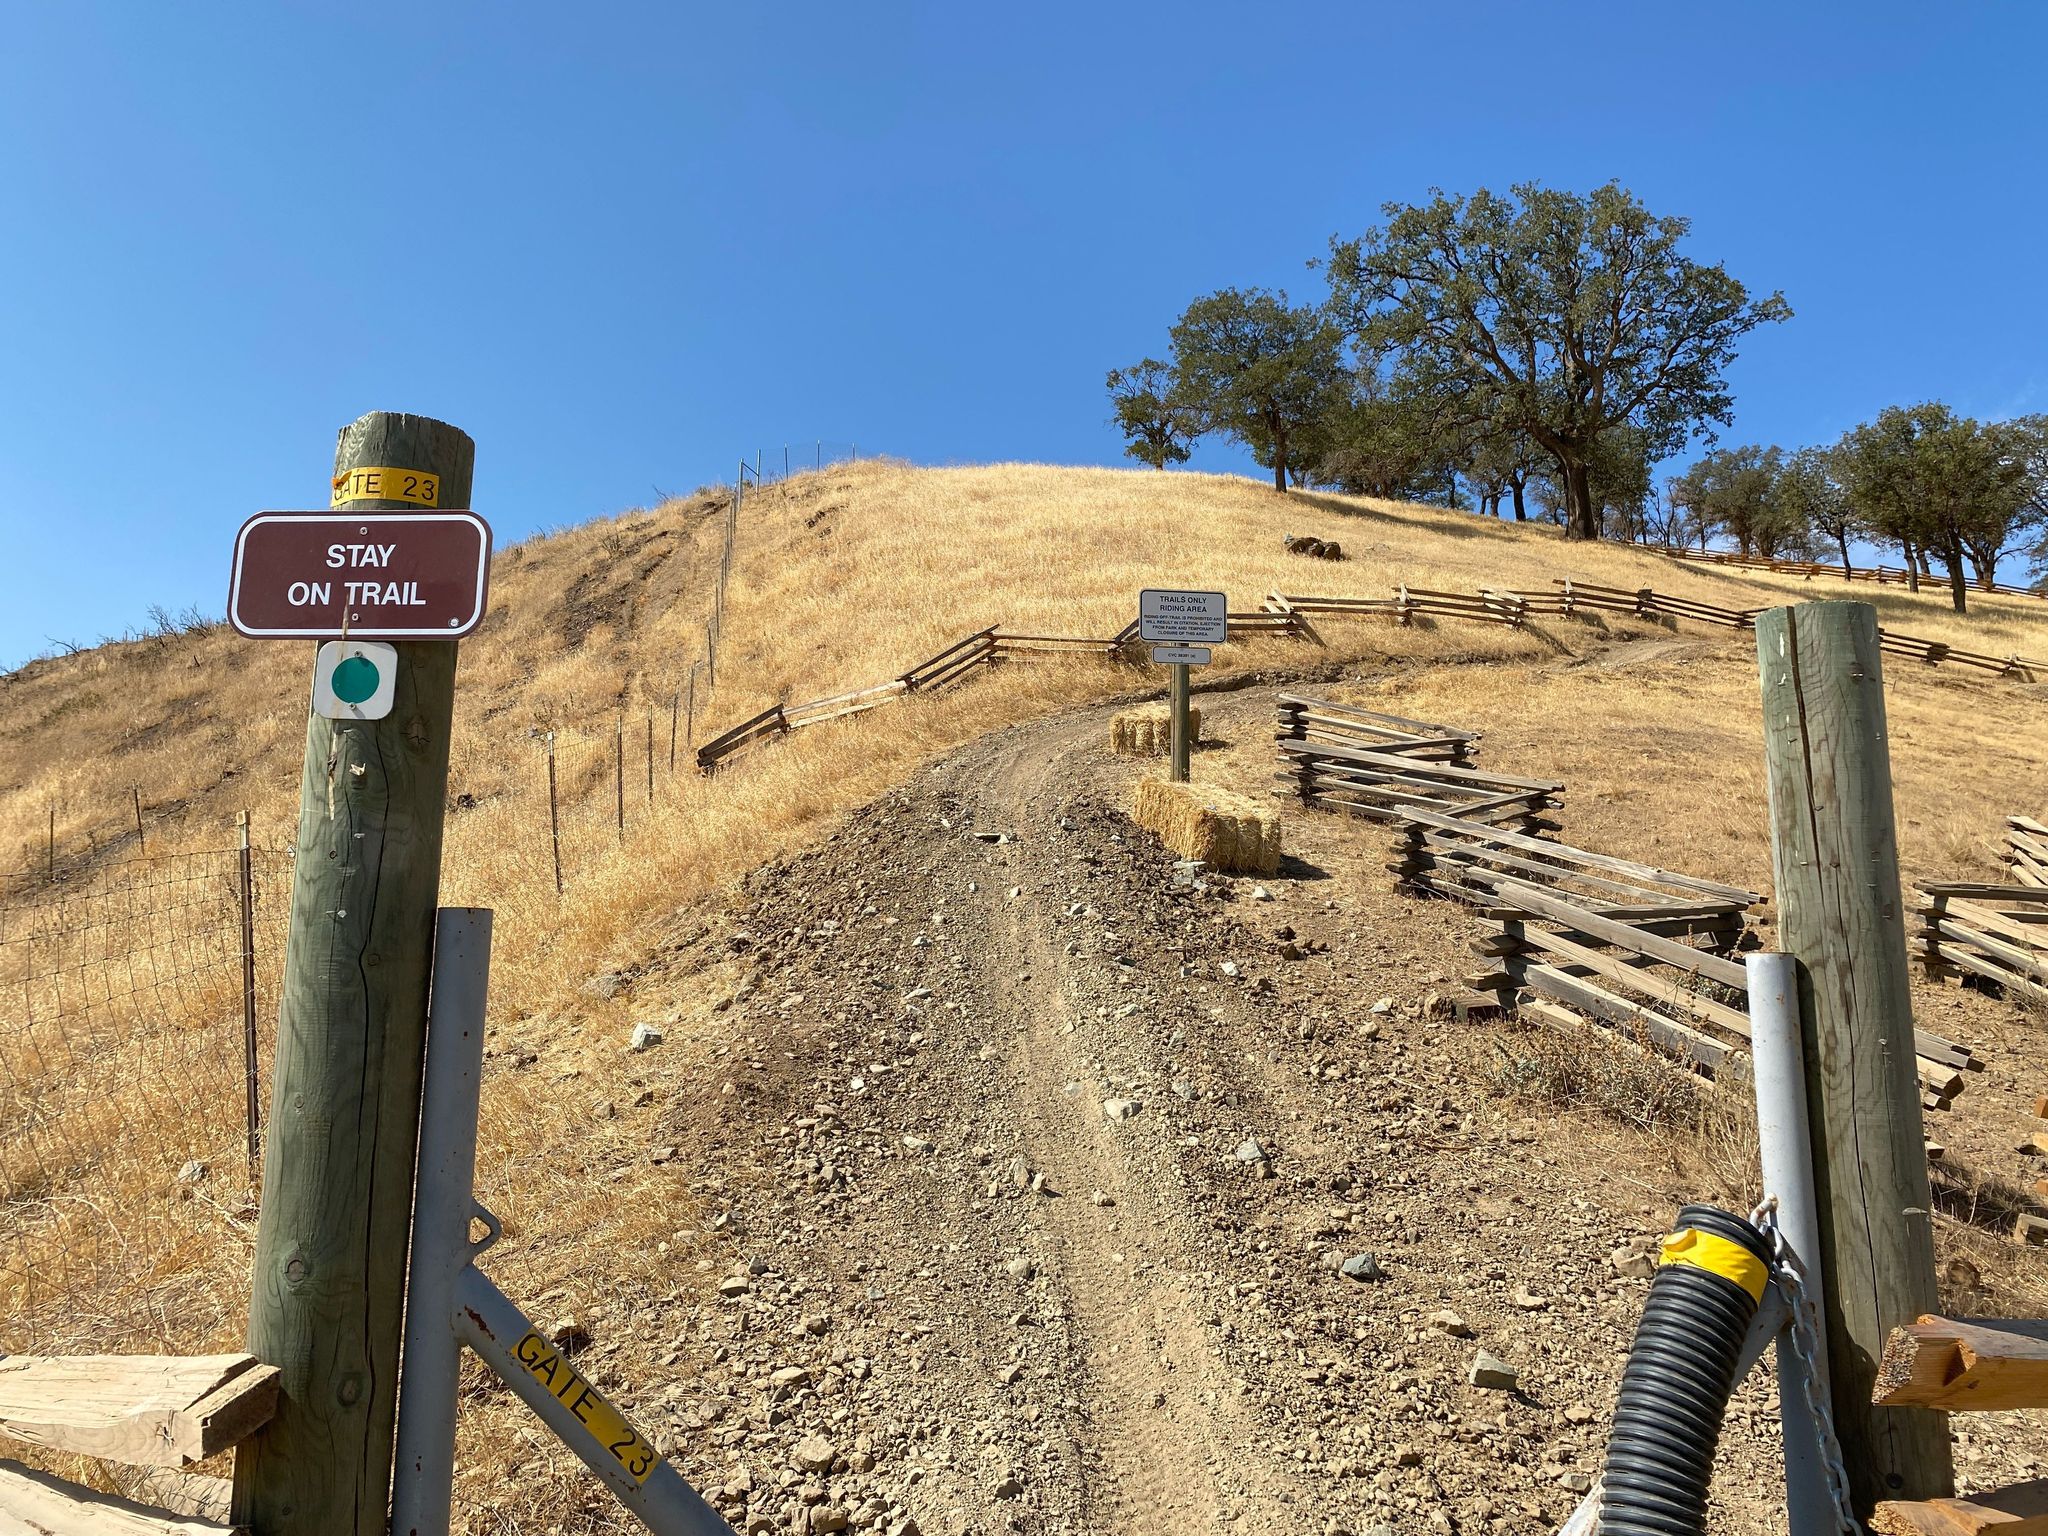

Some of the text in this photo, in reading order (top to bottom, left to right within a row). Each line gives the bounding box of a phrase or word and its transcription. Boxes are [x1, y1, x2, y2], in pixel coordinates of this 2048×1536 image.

[403, 476, 435, 501] 23
[325, 544, 396, 568] STAY
[287, 581, 427, 606] ON TRAIL
[517, 1333, 654, 1477] GATE 23
